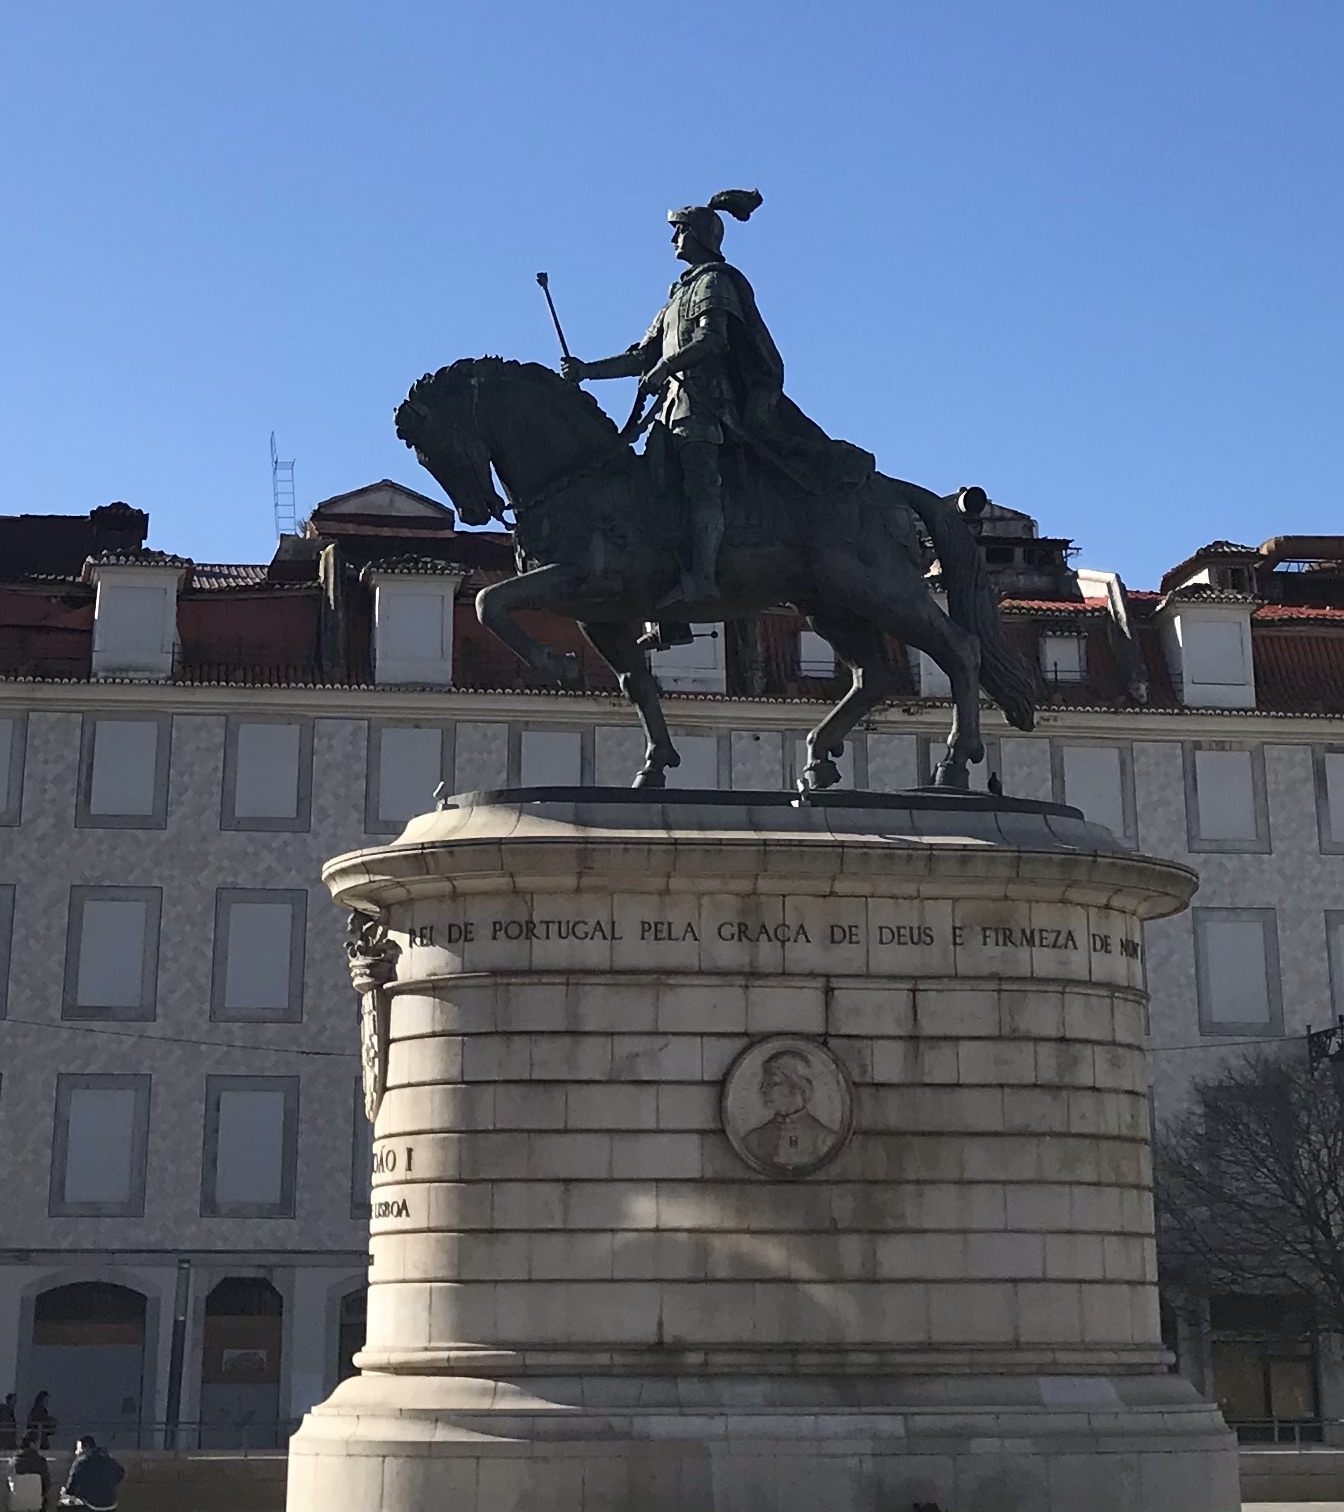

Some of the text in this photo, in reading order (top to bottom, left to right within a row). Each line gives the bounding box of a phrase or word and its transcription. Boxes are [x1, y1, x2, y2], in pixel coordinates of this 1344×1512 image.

[408, 925, 436, 949] REI
[447, 921, 475, 944] DE
[491, 920, 623, 941] PORTUGAL
[640, 920, 700, 942] PELA
[717, 922, 812, 948] GRAÇA
[829, 924, 860, 945] DE
[878, 924, 935, 946] DEUS
[952, 925, 964, 946] E
[981, 926, 1079, 950] FIRMEZA
[1091, 933, 1113, 954] DE
[405, 1146, 414, 1172] I
[375, 1198, 410, 1219] LISBOA
